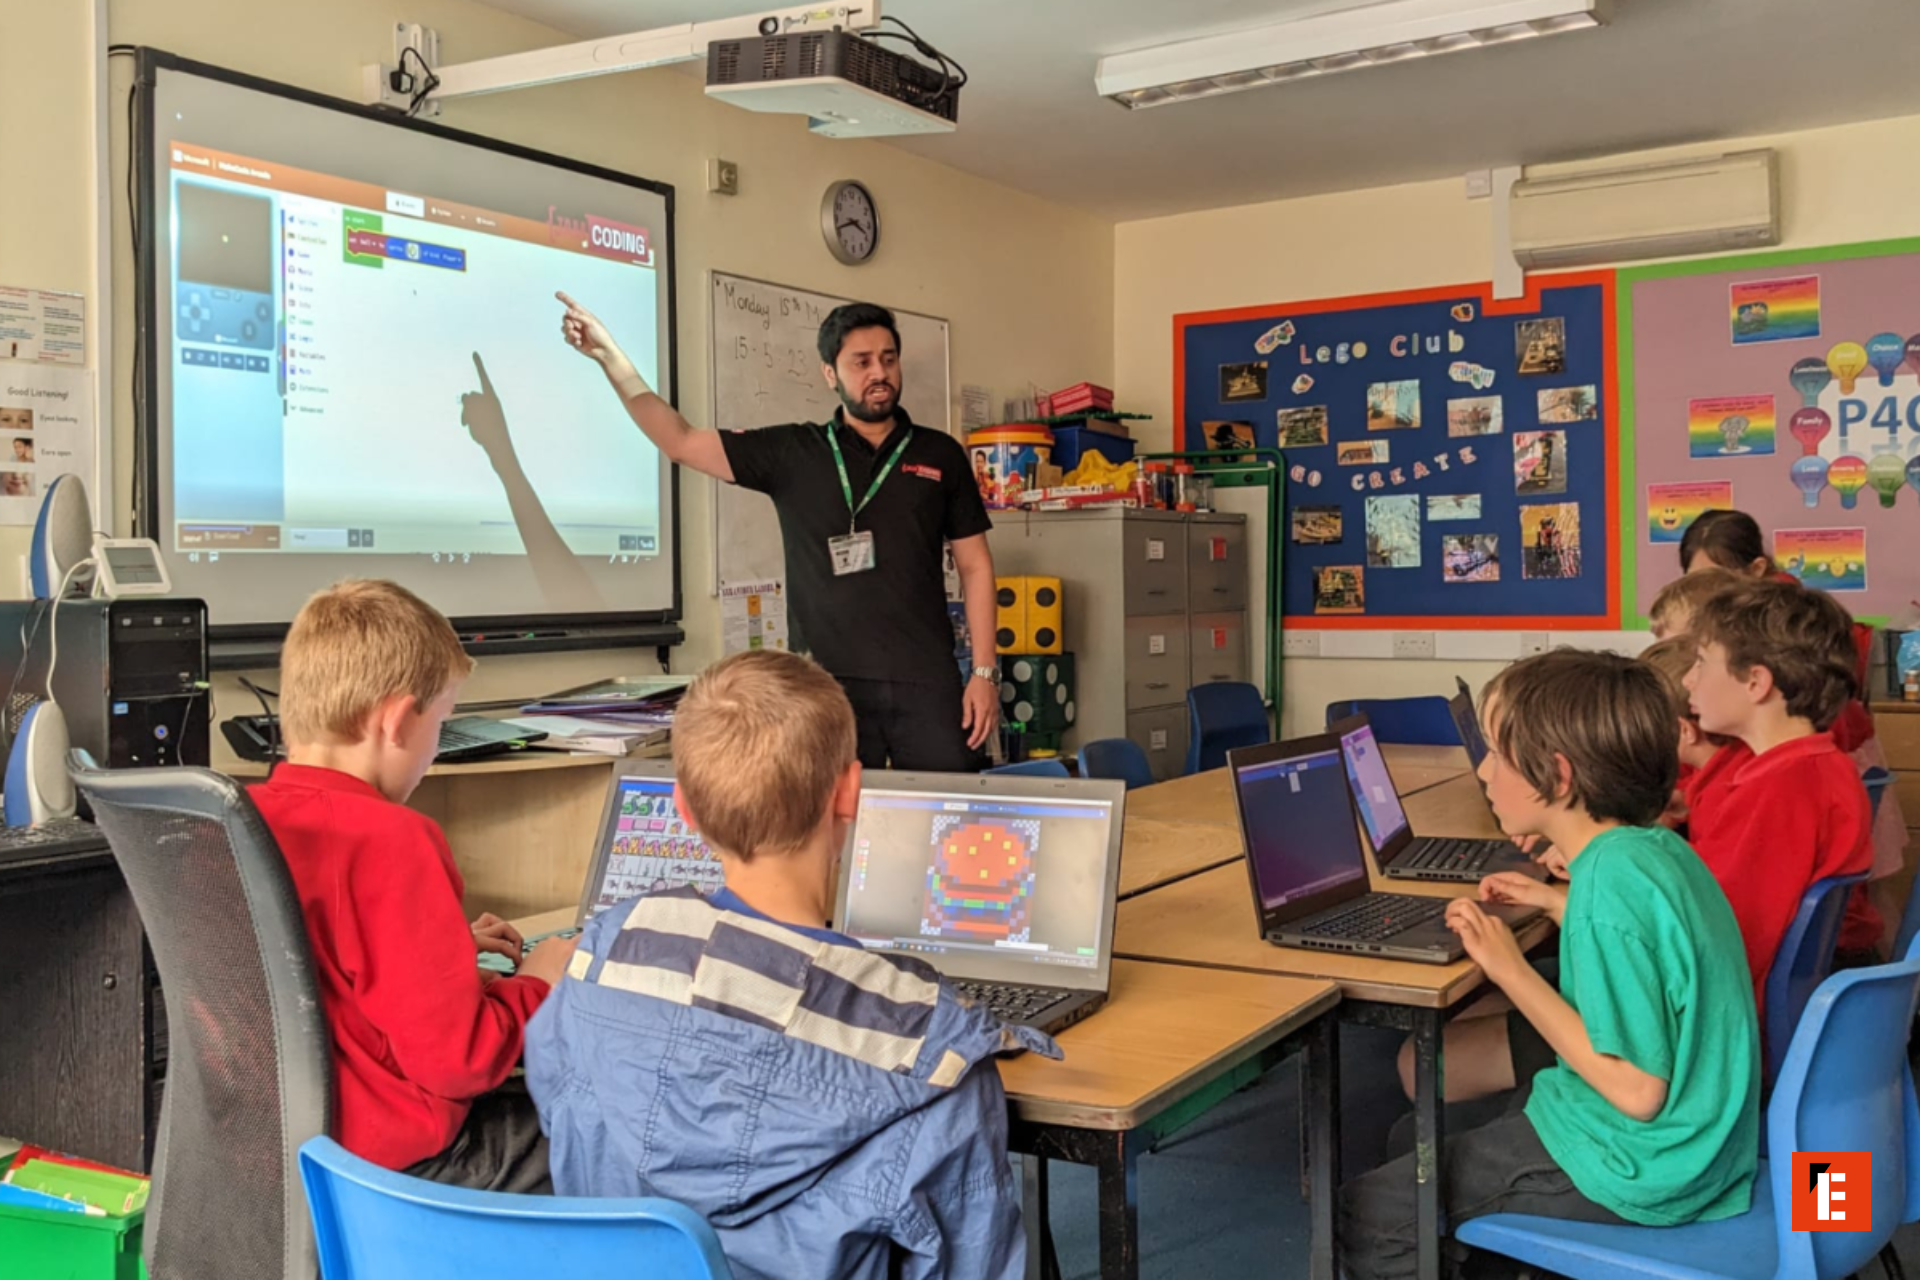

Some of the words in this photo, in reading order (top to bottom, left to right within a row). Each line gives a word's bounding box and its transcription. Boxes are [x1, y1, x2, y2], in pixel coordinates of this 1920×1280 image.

[592, 223, 646, 256] CODING
[723, 282, 770, 331] Monday
[1299, 341, 1368, 365] Lego
[1389, 328, 1465, 358] Club
[7, 386, 29, 397] Good
[1796, 416, 1824, 427] Family
[1290, 464, 1323, 488] GO
[1350, 445, 1477, 492] CREATE
